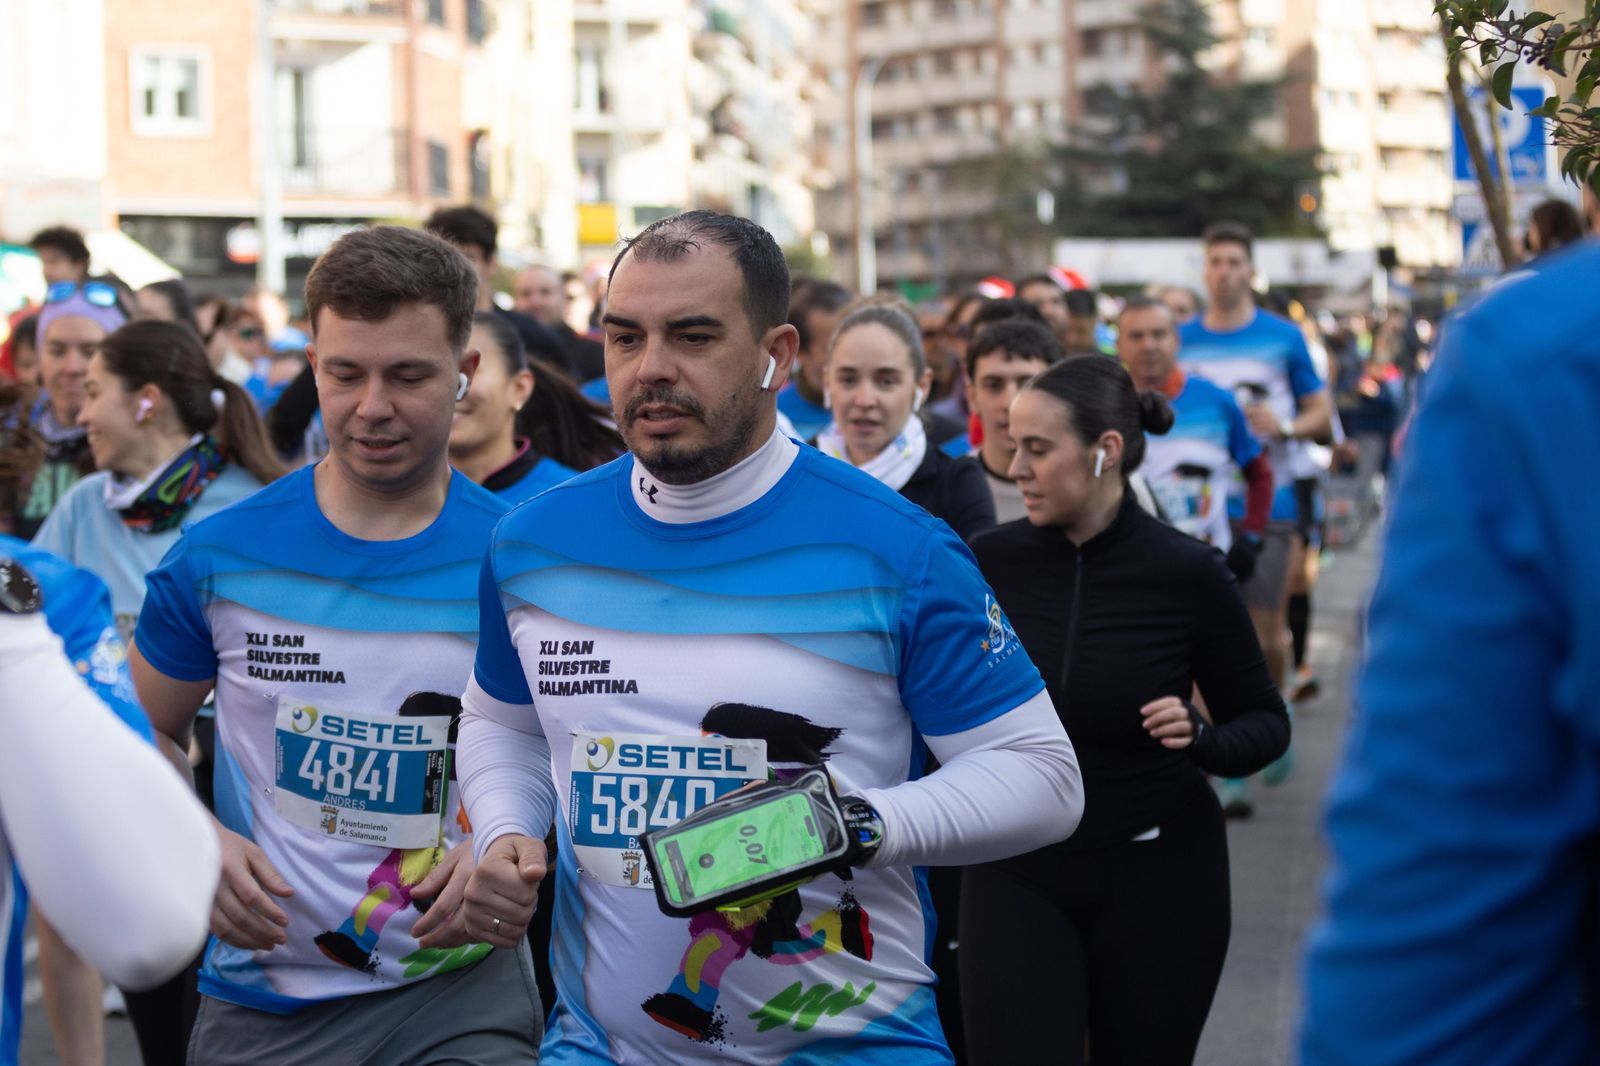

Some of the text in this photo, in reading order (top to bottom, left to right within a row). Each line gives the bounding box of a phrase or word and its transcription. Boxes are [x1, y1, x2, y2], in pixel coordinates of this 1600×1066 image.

[245, 632, 304, 648] XLI SAN
[539, 640, 594, 655] XLI SAN
[246, 649, 320, 665] SILVESTRE
[247, 665, 346, 684] SALMANTINA
[538, 660, 611, 676] SILVESTRE
[538, 679, 639, 696] SALMANTINA
[321, 714, 432, 745] SETEL
[618, 743, 747, 772] SETEL
[298, 740, 399, 803] 4841
[322, 793, 366, 811] ANDRES
[591, 775, 715, 836] 5840
[340, 818, 388, 832] Ayuntamiento
[340, 828, 387, 842] de Salamanca
[739, 824, 768, 866] 0,07
